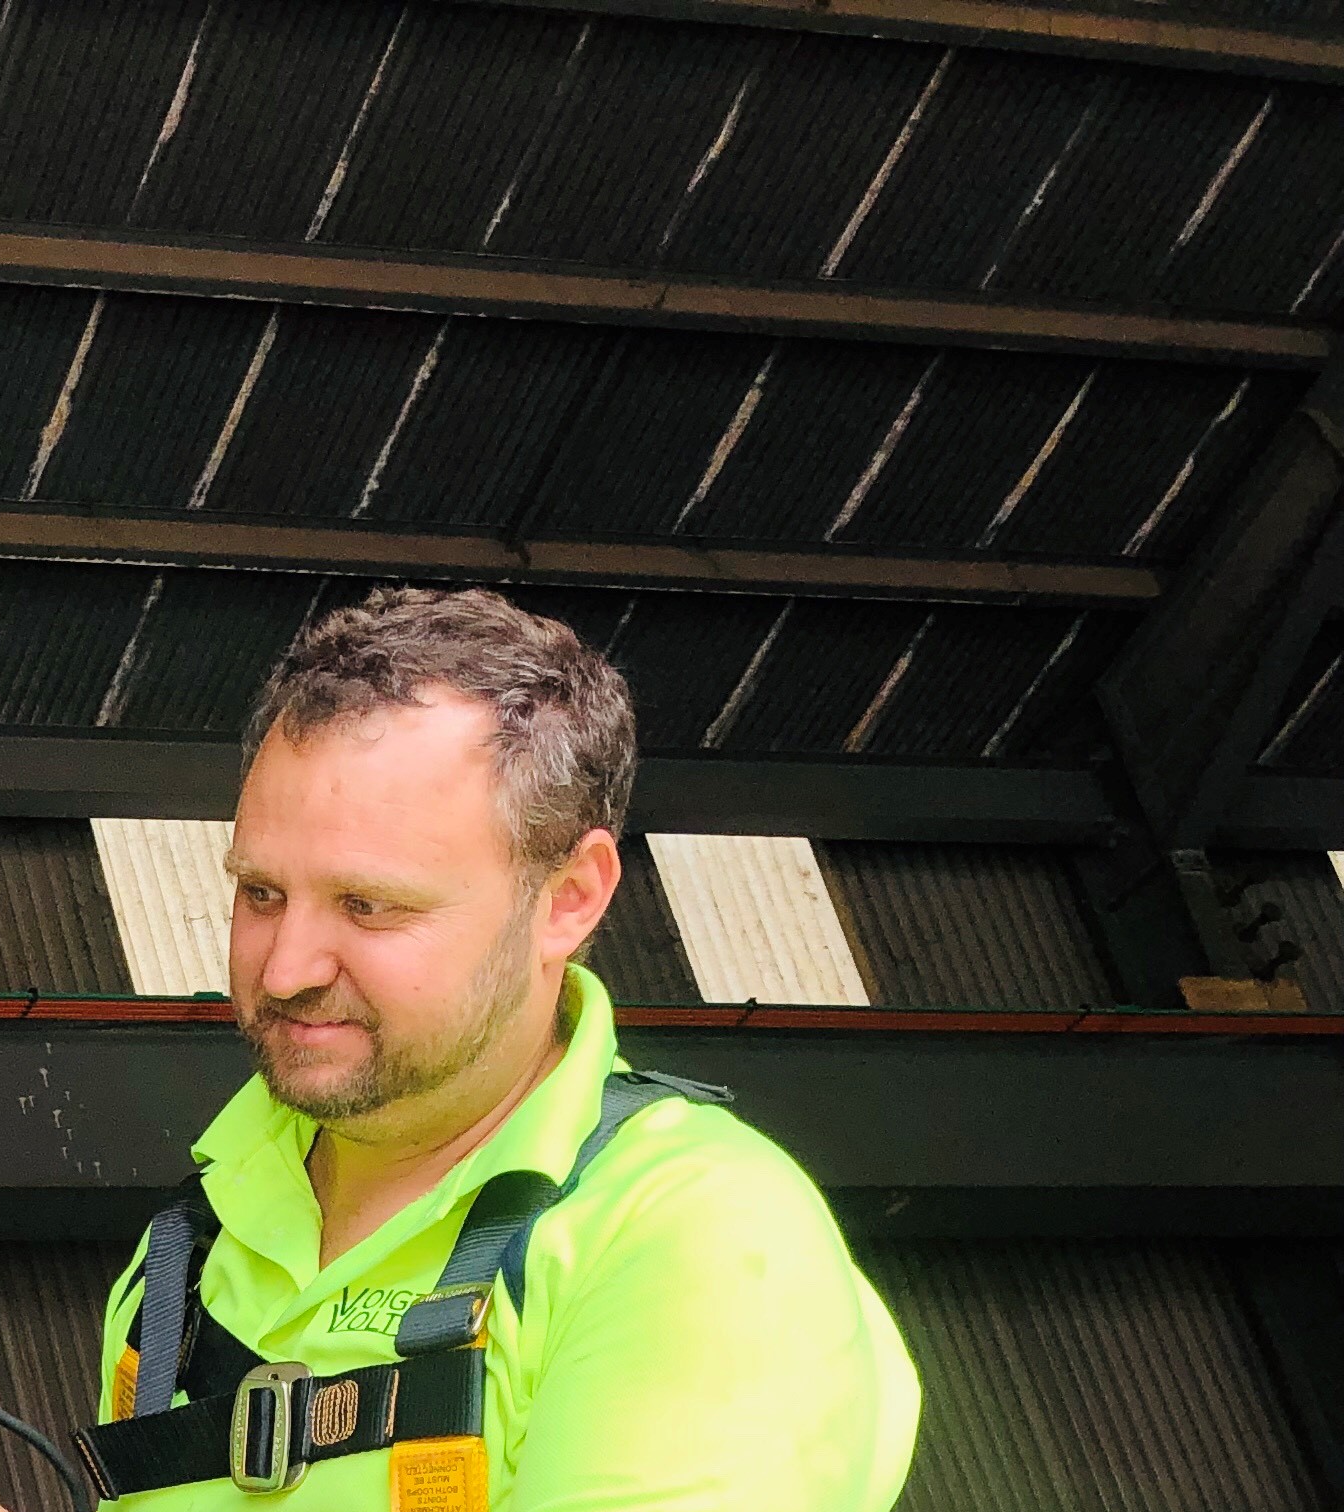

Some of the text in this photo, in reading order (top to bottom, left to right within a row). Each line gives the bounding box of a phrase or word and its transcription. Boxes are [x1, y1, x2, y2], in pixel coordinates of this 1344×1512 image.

[340, 1286, 426, 1316] VOIG
[427, 1476, 449, 1484] MUST
[436, 1486, 458, 1494] BOTH
